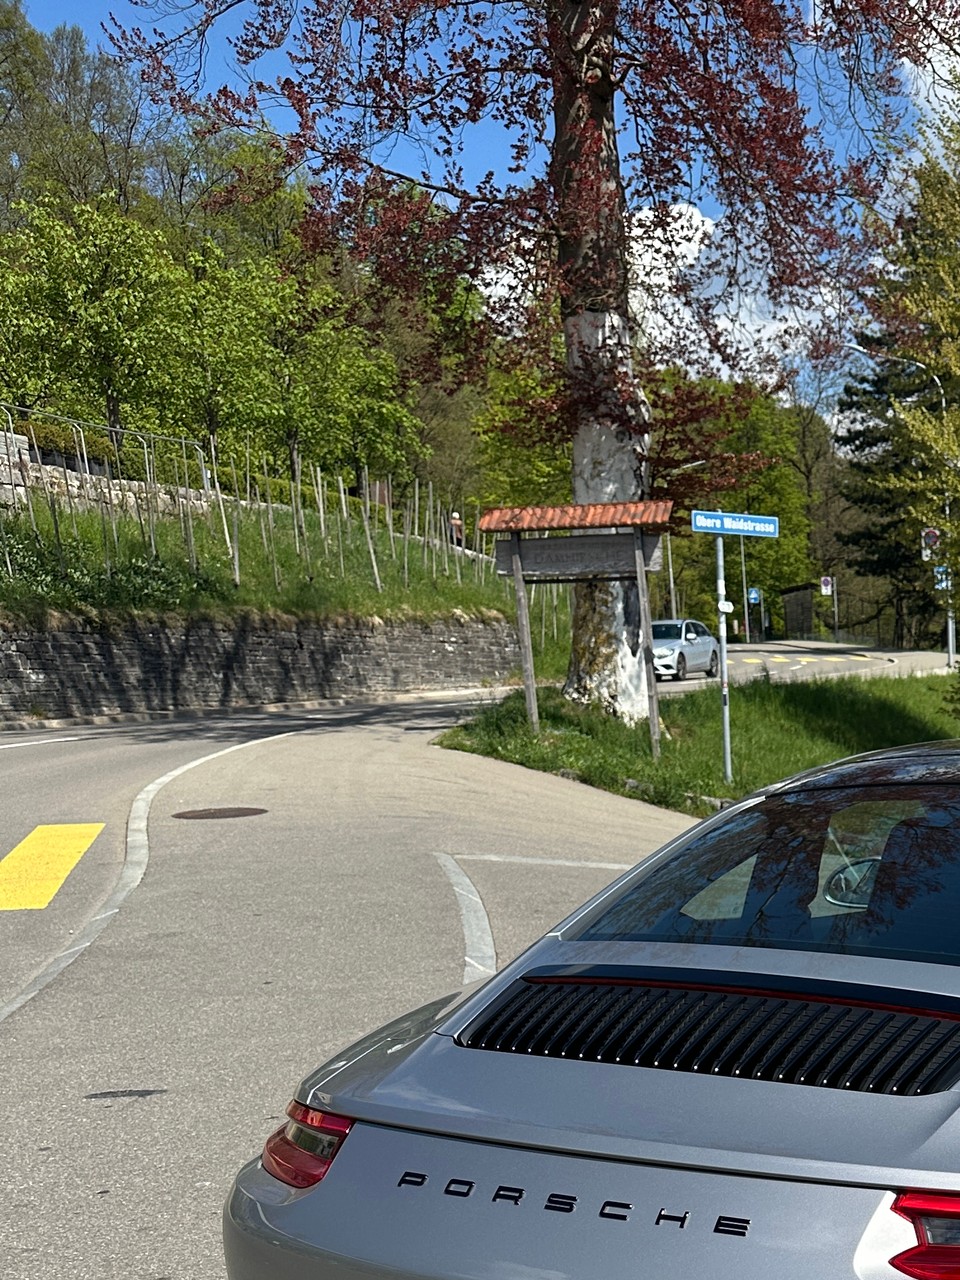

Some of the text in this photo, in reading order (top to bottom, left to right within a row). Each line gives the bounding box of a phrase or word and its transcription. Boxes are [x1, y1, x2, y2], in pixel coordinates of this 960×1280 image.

[695, 514, 775, 533] Obere Waidstrasse
[396, 1170, 752, 1238] PORSCHE
